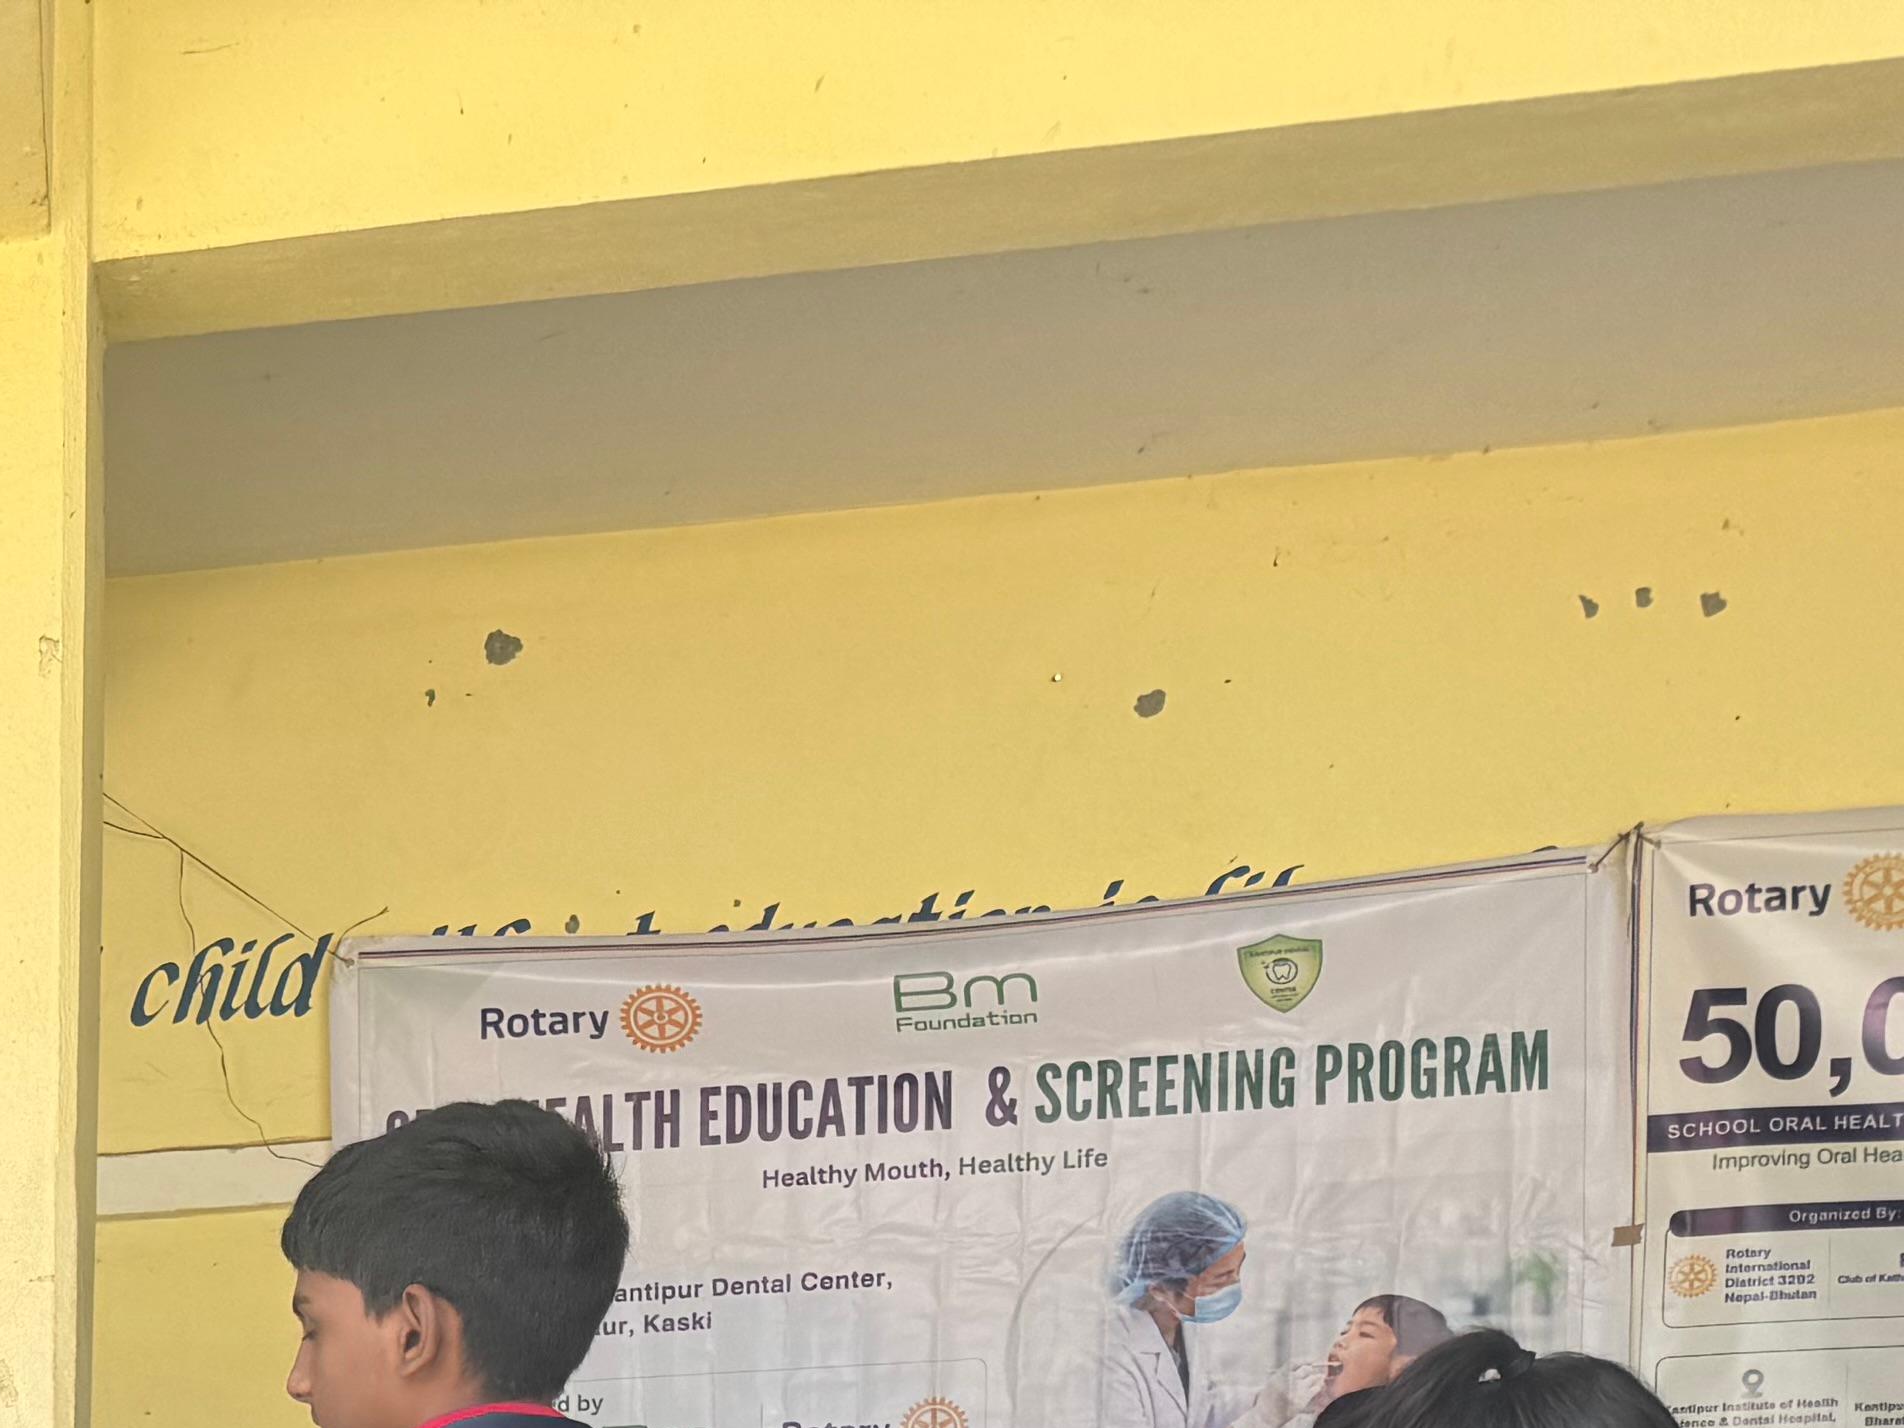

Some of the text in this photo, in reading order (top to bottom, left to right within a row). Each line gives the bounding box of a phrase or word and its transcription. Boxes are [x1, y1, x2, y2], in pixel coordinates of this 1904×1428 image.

[1689, 882, 1832, 917] Rotary
[130, 932, 334, 1027] child
[480, 1006, 609, 1040] Rotary
[895, 1008, 1039, 1033] Foundation
[538, 1028, 1551, 1152] ALTH EDUCATION & SCREENING PROGRAM
[1667, 1120, 1760, 1139] SCHOOL
[1769, 1117, 1827, 1132] ORAL
[762, 1147, 1109, 1190] Healthy Mouth, Healthy Life
[1713, 1149, 1811, 1172] Improving
[1817, 1146, 1857, 1165] Oral
[1789, 1208, 1871, 1225] Organized
[1726, 1248, 1772, 1260] Rotary
[1725, 1260, 1811, 1274] International
[614, 1271, 893, 1306] antipur Dental Center,
[1725, 1275, 1775, 1288] District
[643, 1311, 712, 1334] Kaski
[577, 1394, 604, 1415] by
